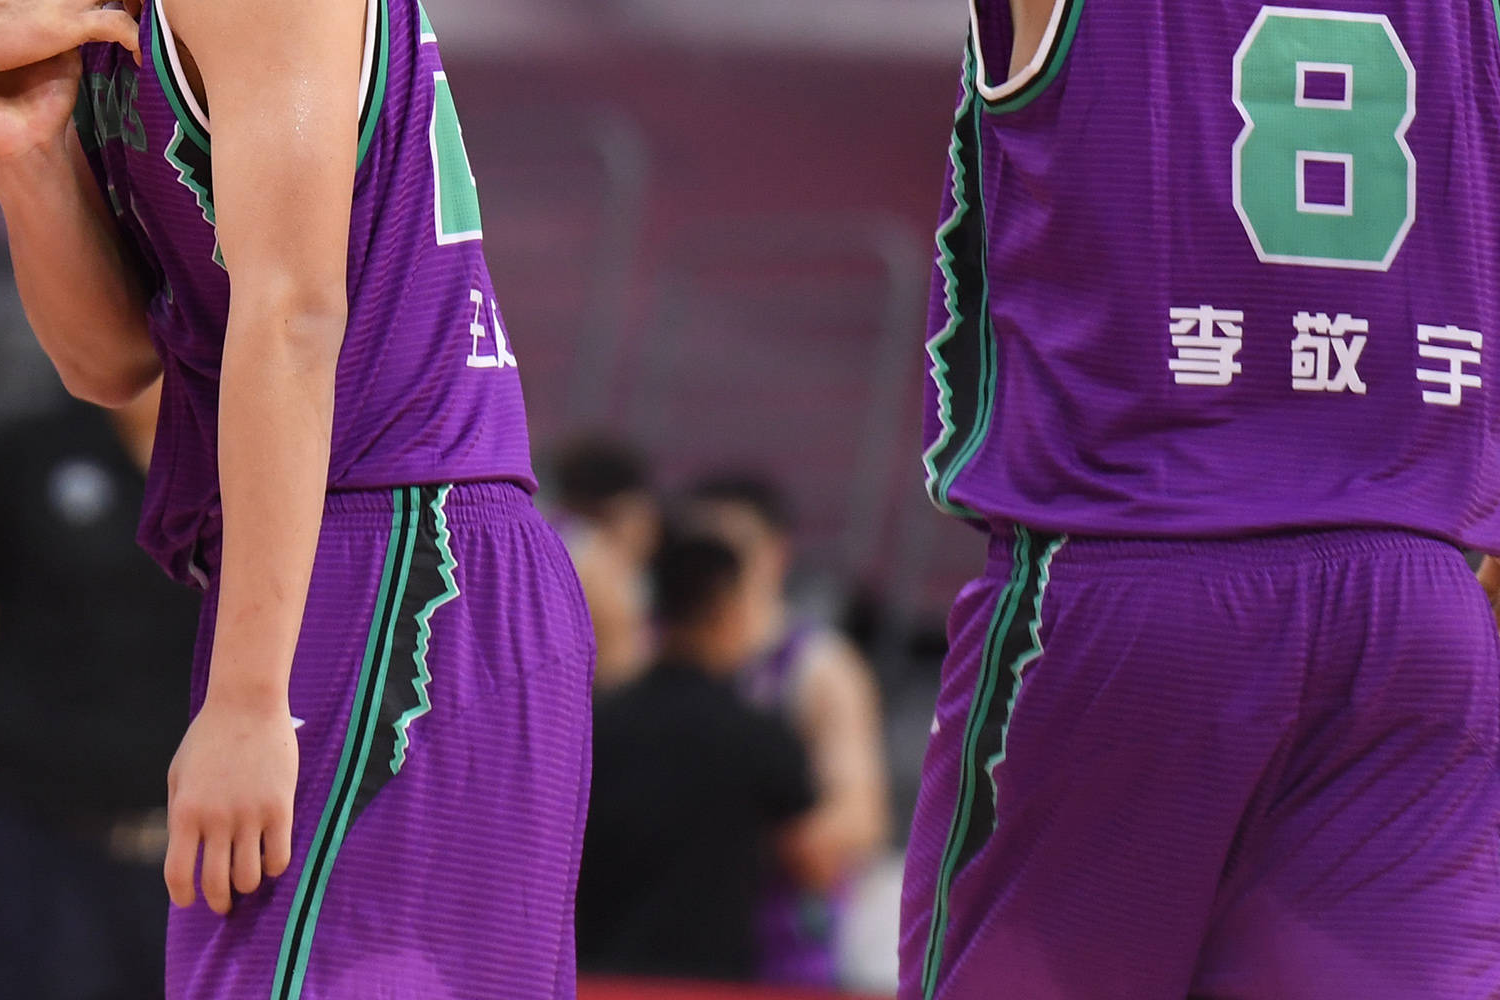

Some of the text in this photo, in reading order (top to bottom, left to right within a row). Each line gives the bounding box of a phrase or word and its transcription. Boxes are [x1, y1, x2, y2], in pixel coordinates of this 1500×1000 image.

[1232, 4, 1417, 273] 8
[1168, 304, 1483, 406] 李敬宇
